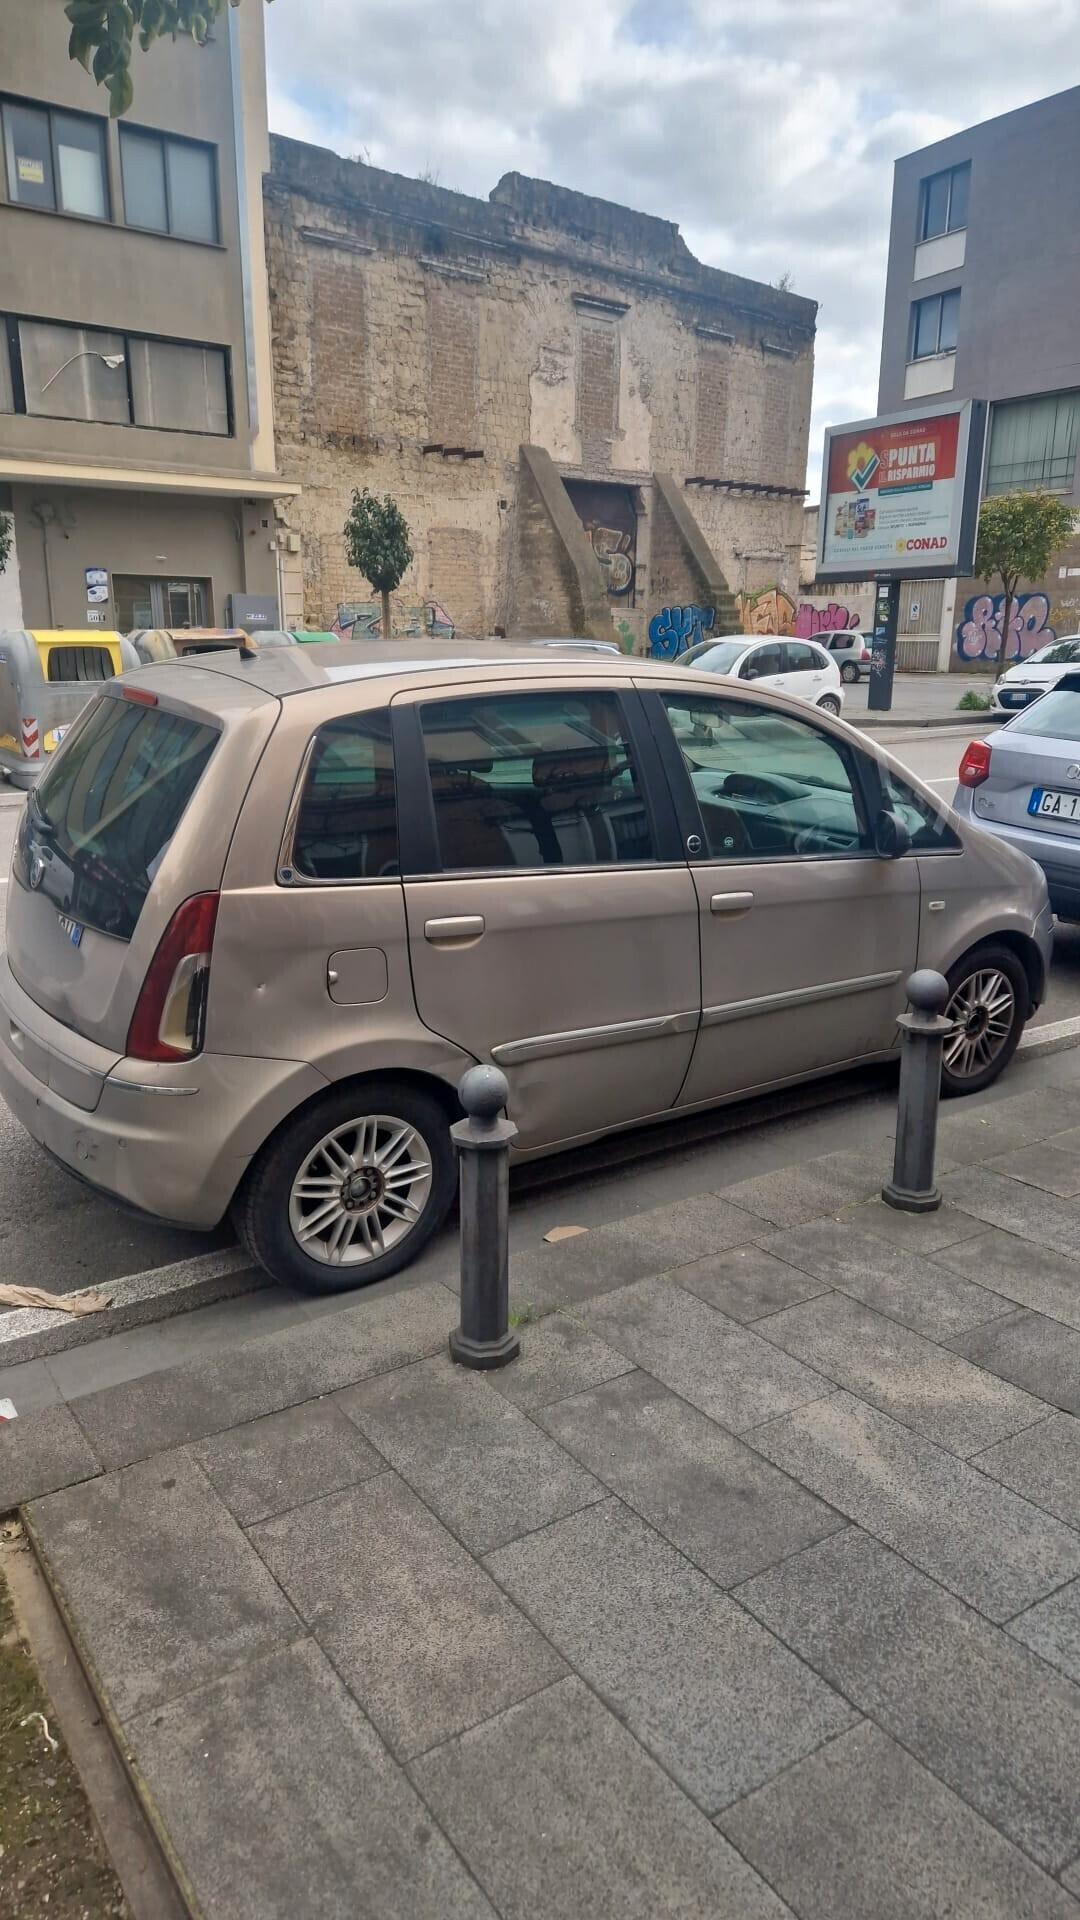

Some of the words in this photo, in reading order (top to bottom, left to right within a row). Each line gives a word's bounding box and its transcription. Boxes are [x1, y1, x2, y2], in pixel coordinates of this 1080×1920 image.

[879, 443, 935, 469] SPUNTA
[887, 463, 936, 482] RISPARMIO
[906, 536, 948, 551] CONAD
[1042, 793, 1062, 814] GA
